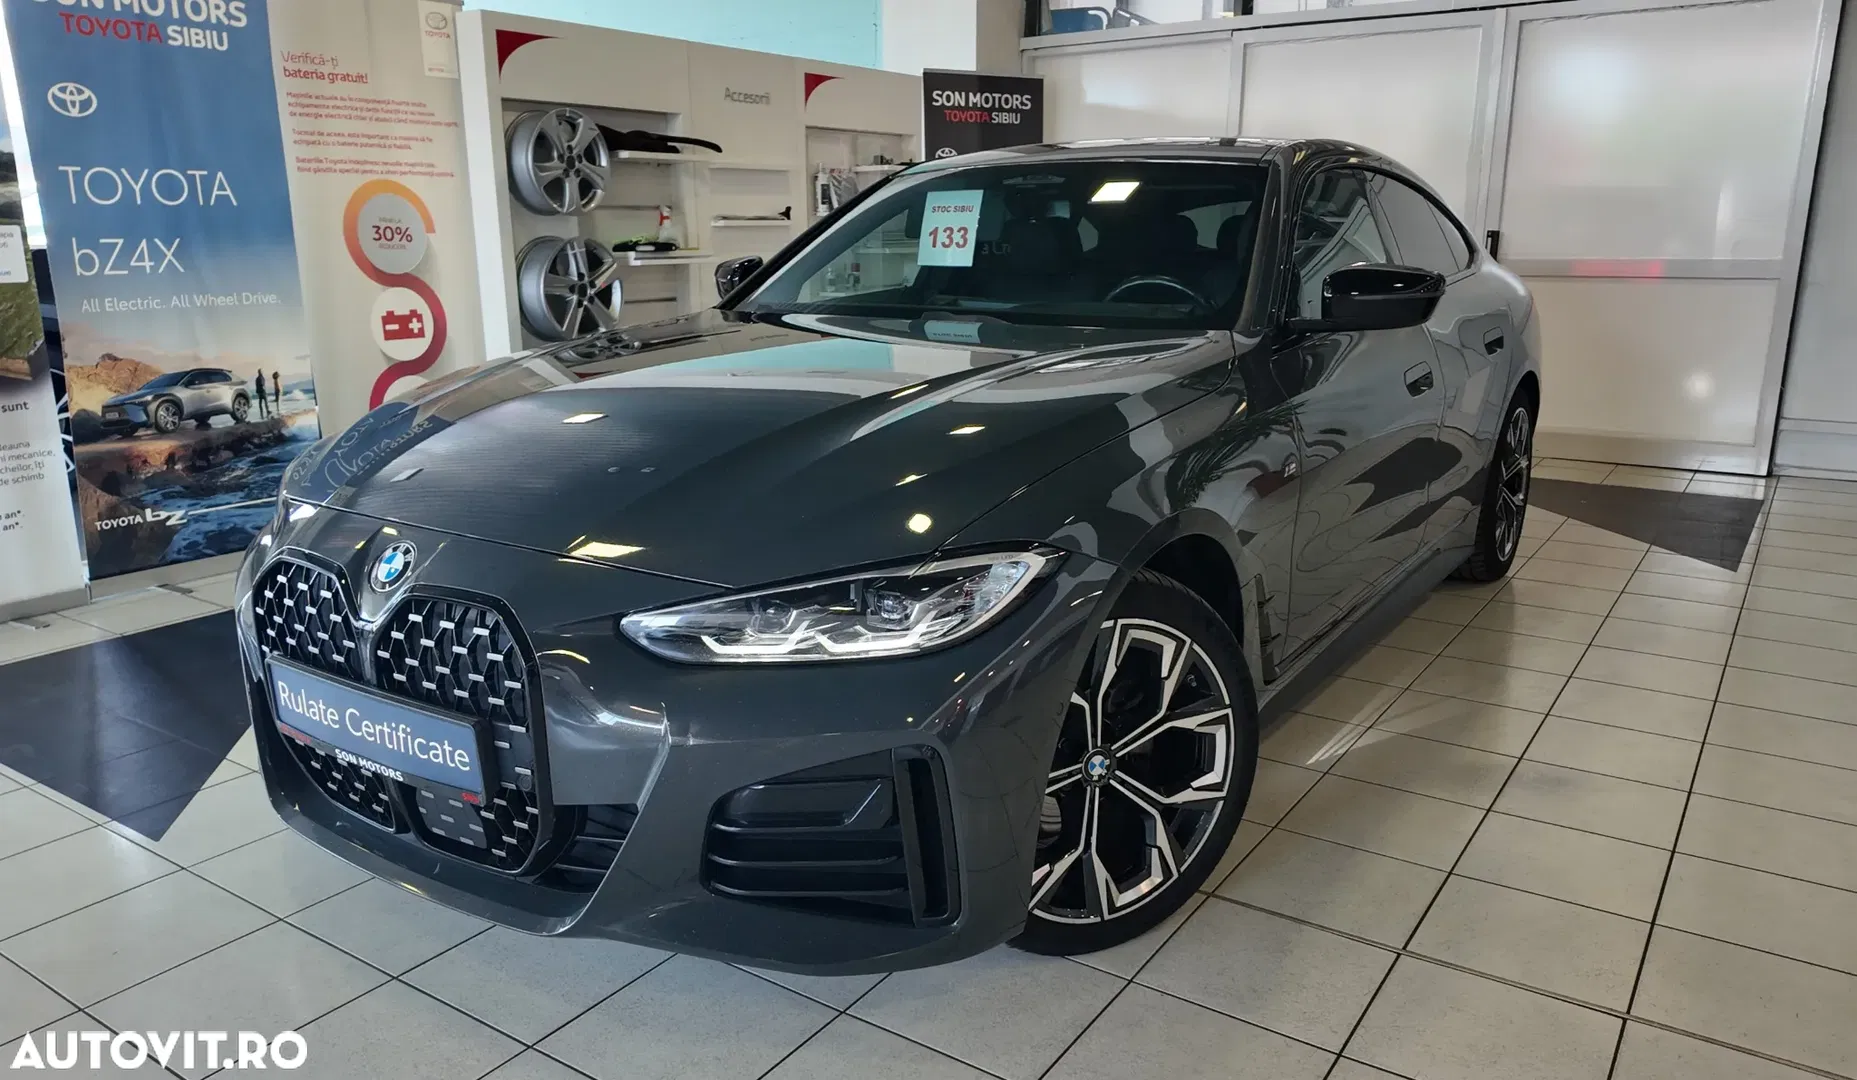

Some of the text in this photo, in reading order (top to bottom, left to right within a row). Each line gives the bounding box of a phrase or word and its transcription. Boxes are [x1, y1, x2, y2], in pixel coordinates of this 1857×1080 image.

[59, 12, 229, 51] TOYOTA SIBIU
[283, 66, 368, 84] bateria gratuit!
[724, 86, 770, 104] Accesorii
[932, 90, 1032, 110] SON MOTORS
[944, 110, 1021, 124] TOYOTA SIBIU
[58, 166, 238, 206] TOYOTA
[932, 205, 975, 213] STOC SIBIU
[372, 225, 413, 243] 30%
[928, 226, 969, 249] 133
[72, 237, 185, 276] bZ4X
[81, 291, 281, 314] All Electric. All Wheel Drive.
[1, 401, 29, 413] sunt
[11, 472, 45, 484] schimb
[94, 515, 143, 531] TOYOTA
[278, 681, 470, 771] Rulate Certificate
[335, 748, 404, 782] SON MOTORS
